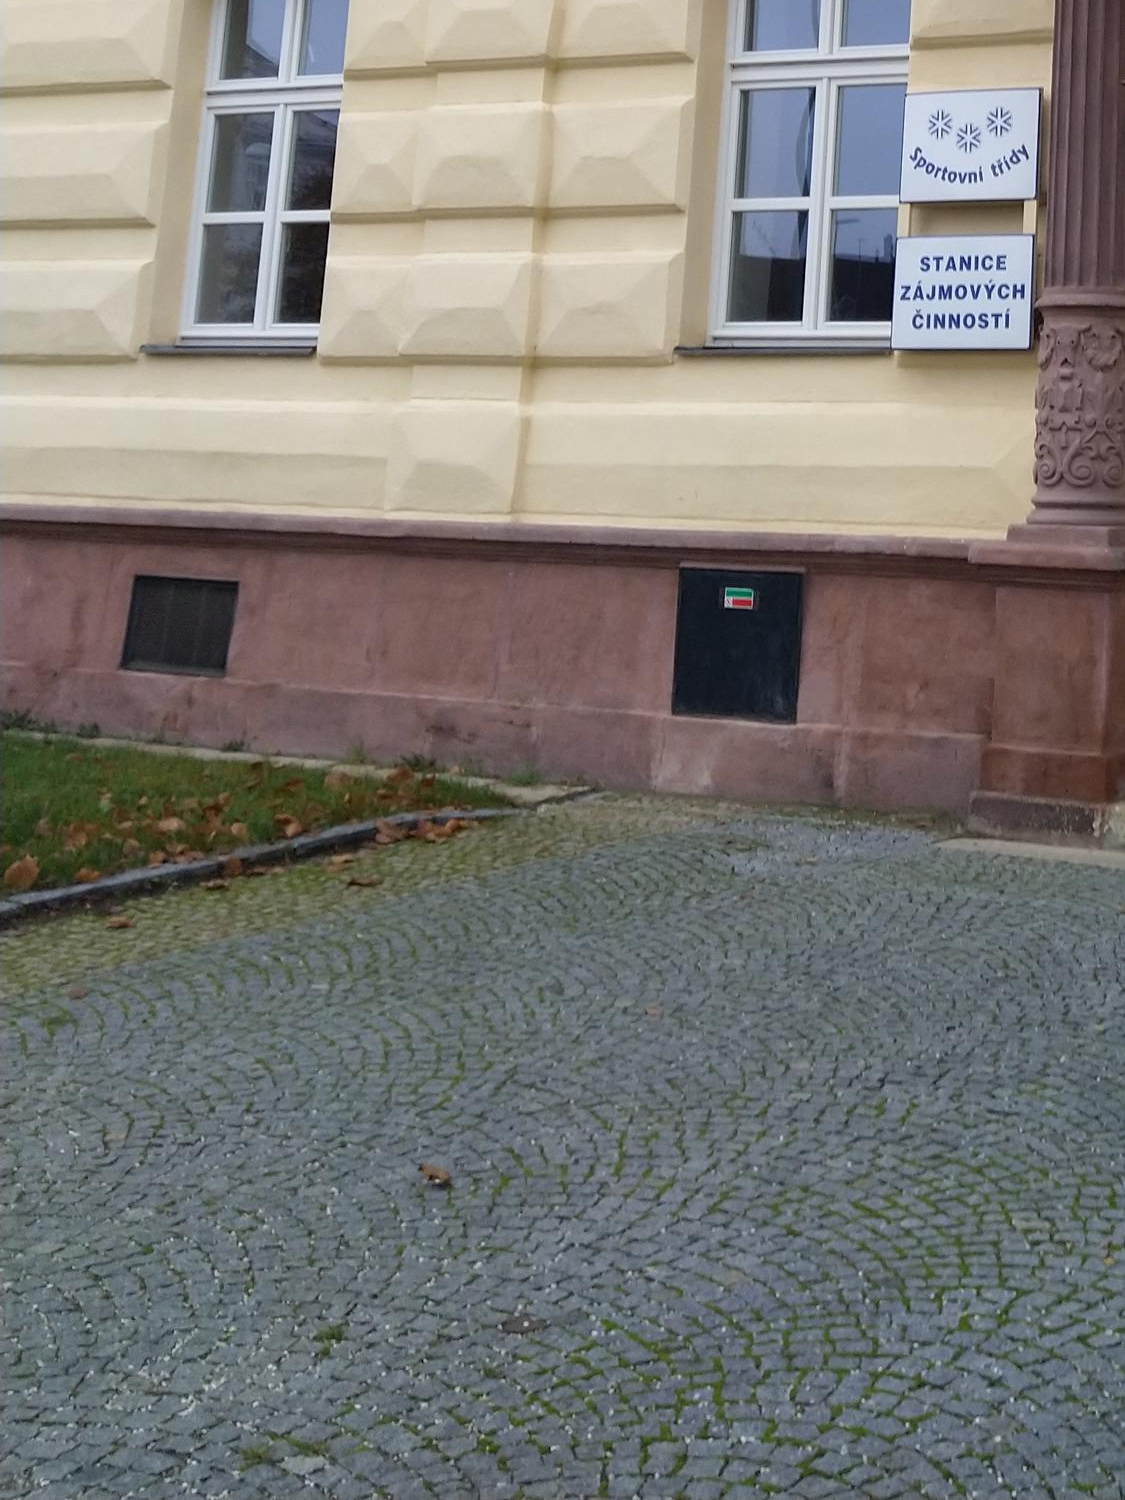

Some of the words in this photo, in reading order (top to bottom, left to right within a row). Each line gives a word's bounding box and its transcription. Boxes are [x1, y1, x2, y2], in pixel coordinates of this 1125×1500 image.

[909, 146, 984, 184] Sportovní
[990, 144, 1030, 178] třídy
[919, 255, 1007, 272] STANICE
[900, 279, 1026, 301] ZÁJMOVÝCH
[911, 308, 1011, 330] ČINNOSTÍ
